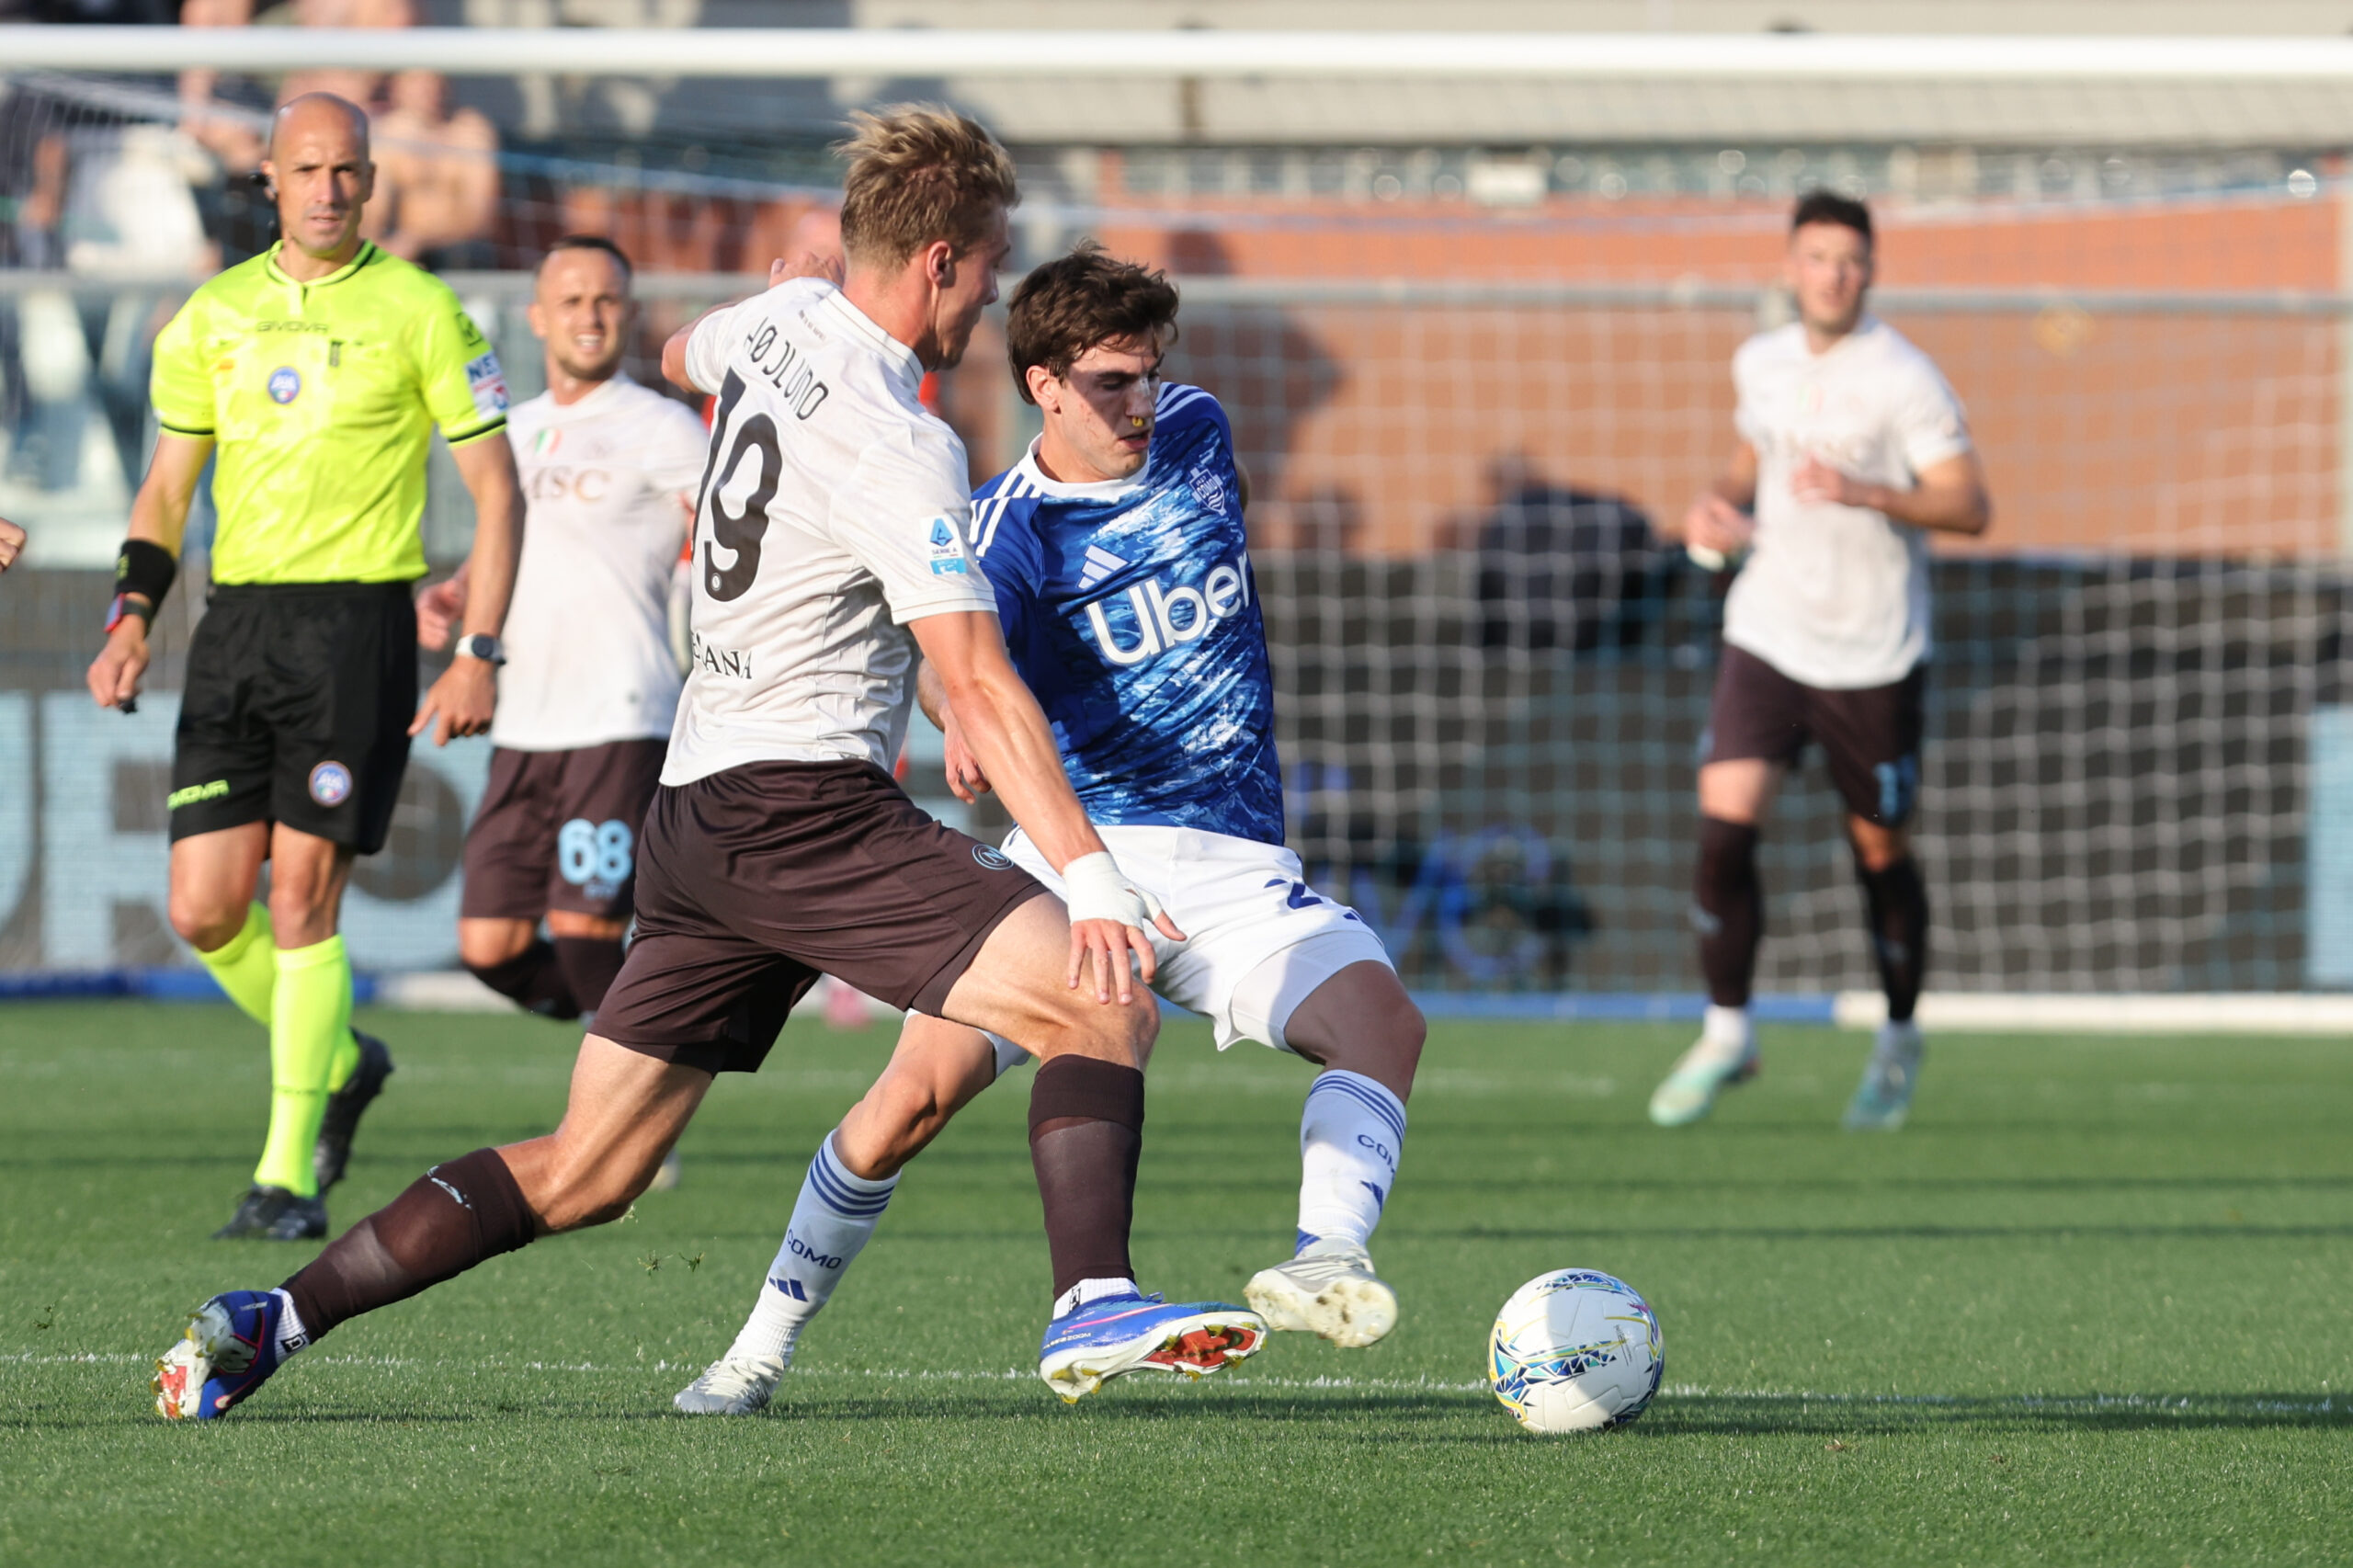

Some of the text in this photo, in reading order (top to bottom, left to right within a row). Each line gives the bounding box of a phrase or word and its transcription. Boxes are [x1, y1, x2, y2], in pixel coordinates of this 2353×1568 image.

[691, 365, 783, 603] 19
[1086, 551, 1251, 665] Uber
[557, 818, 634, 885] 68
[788, 1228, 843, 1269] COMO
